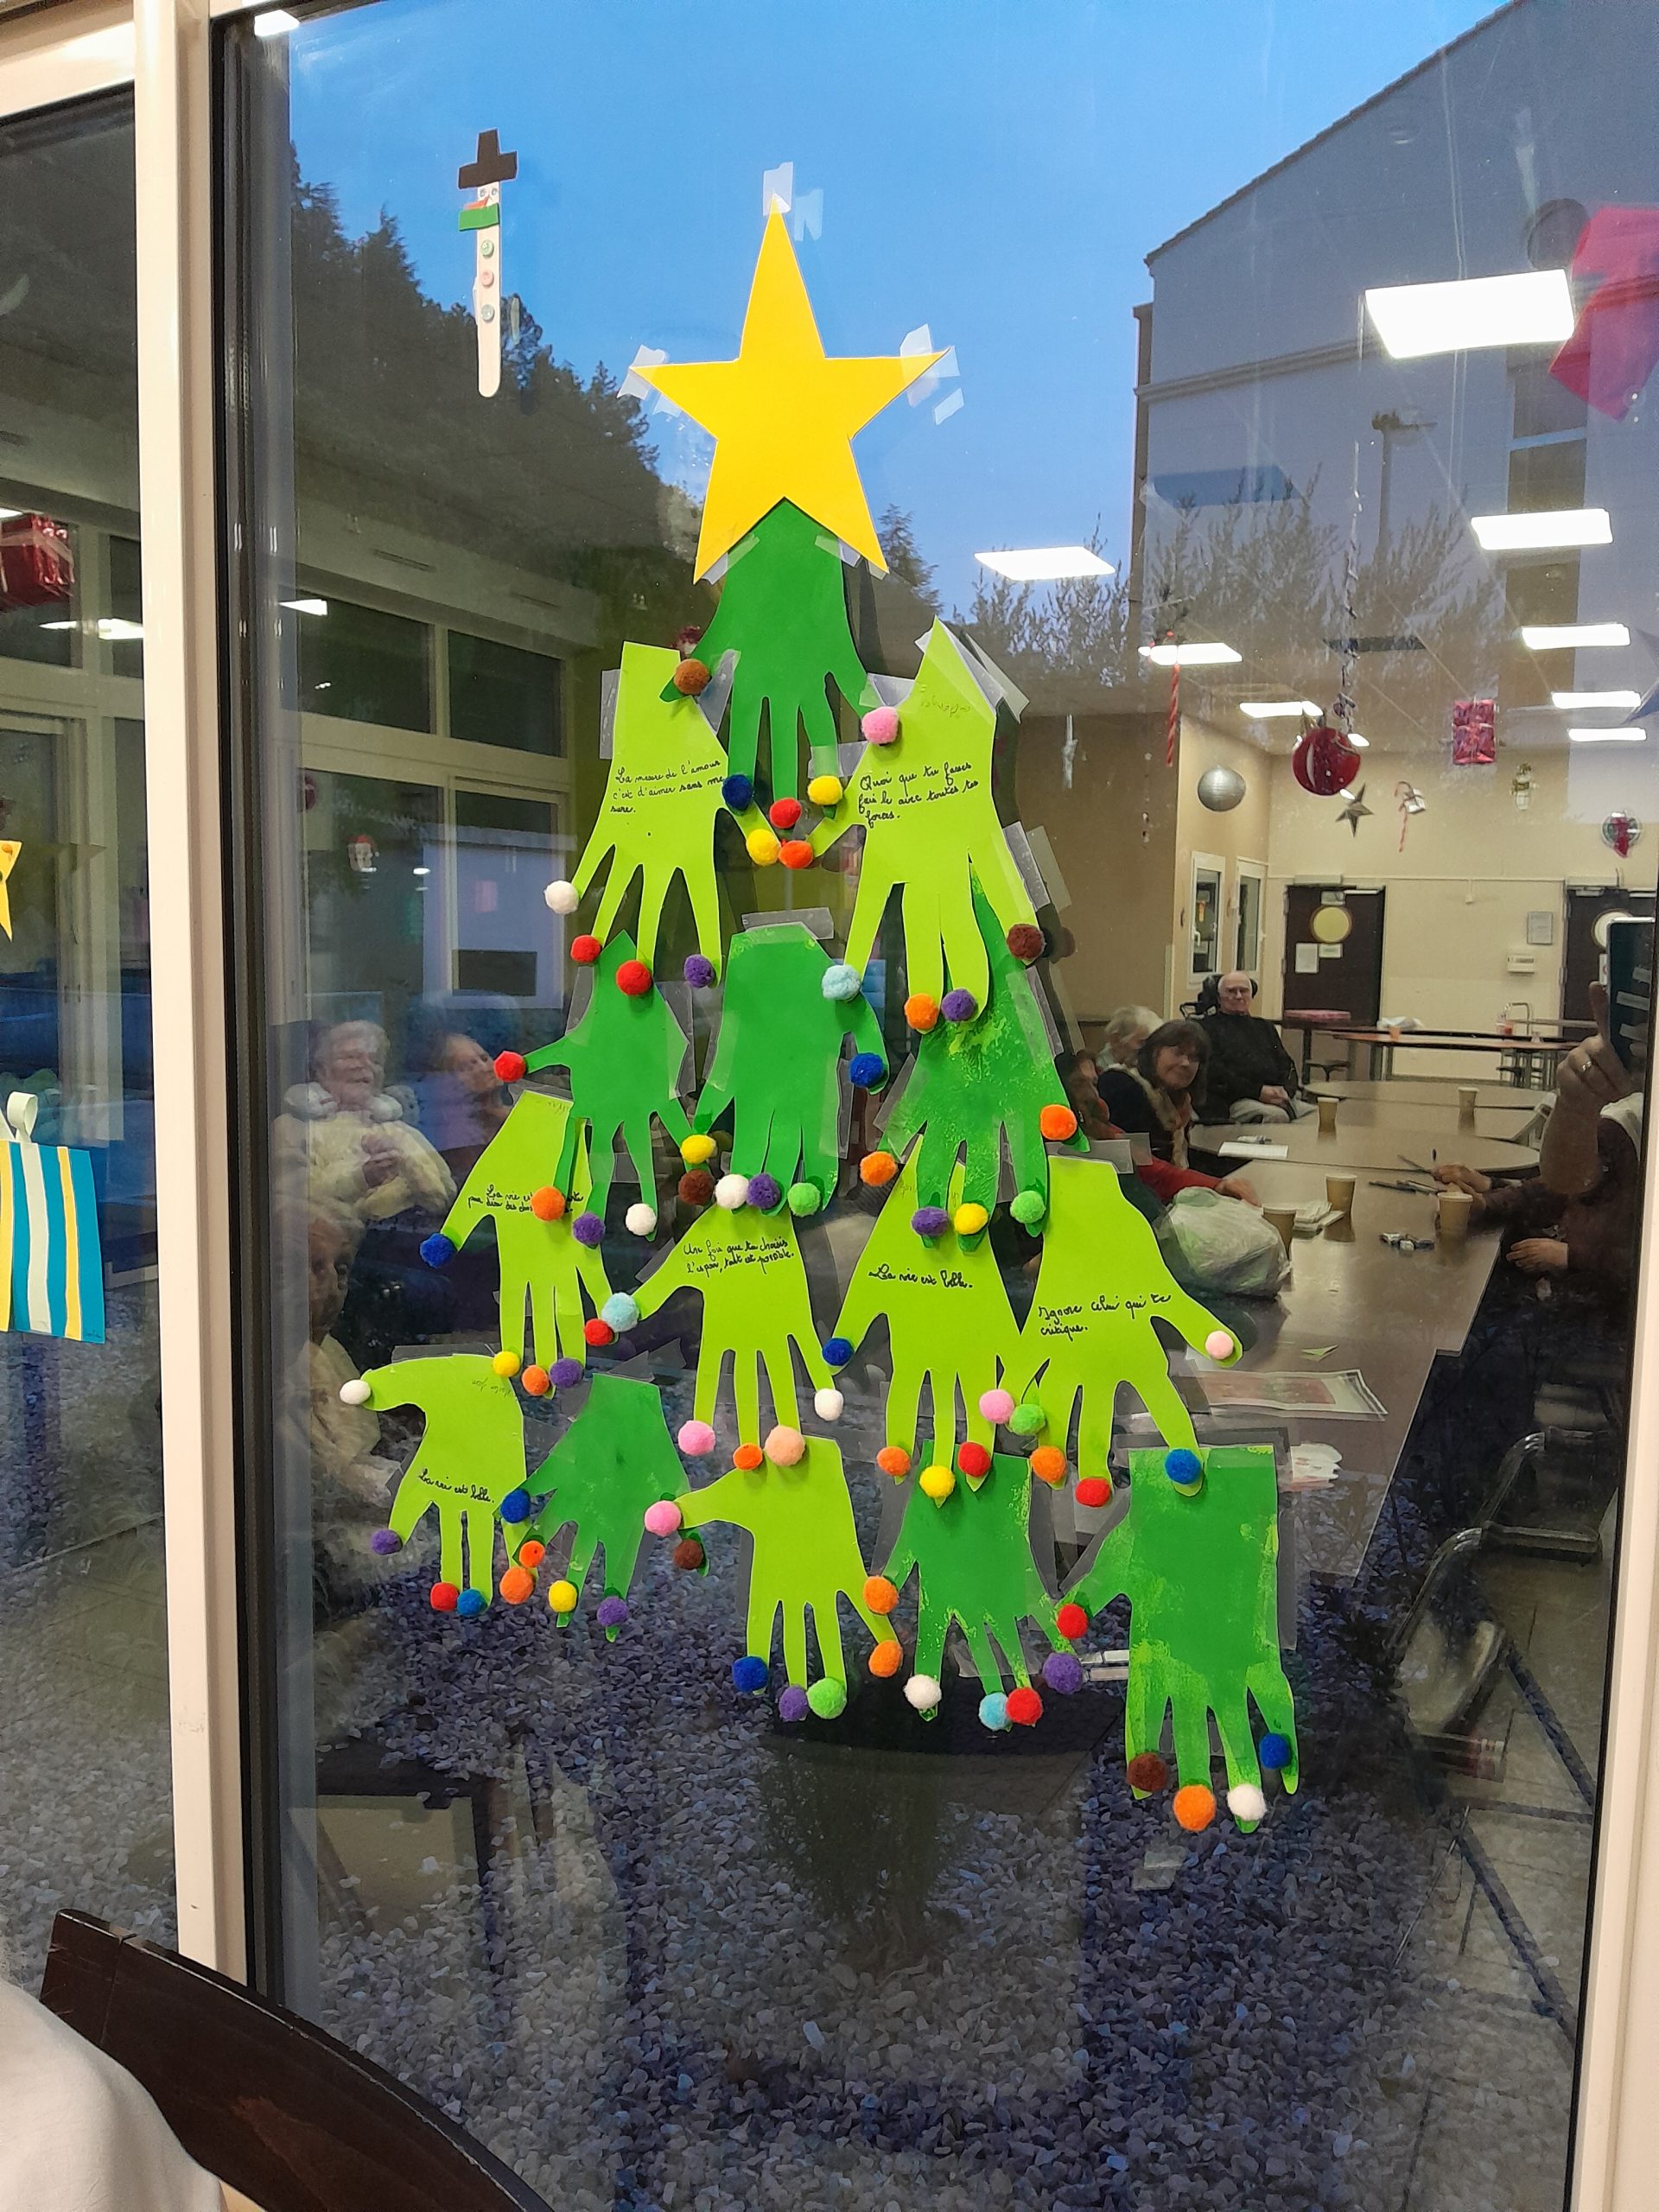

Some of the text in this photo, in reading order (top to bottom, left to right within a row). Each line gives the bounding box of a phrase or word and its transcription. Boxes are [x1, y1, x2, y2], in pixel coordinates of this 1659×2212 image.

[615, 766, 632, 784] La
[635, 774, 664, 784] mesure
[665, 768, 677, 779] de
[860, 771, 893, 791] Quoi
[899, 773, 918, 798] que
[923, 766, 939, 777] tu
[613, 787, 633, 800] c'est
[637, 785, 676, 797] d'aimer
[679, 780, 702, 792] sans
[858, 793, 877, 814] fais
[898, 795, 923, 805] avec
[925, 785, 959, 801] toutes
[962, 779, 979, 793] tes
[505, 1191, 520, 1200] vie
[705, 1239, 723, 1262] fois
[726, 1245, 744, 1262] que
[899, 1268, 918, 1282] vie
[920, 1274, 938, 1285] est
[1090, 1294, 1121, 1312] celui
[1125, 1295, 1147, 1320] qui
[1150, 1294, 1172, 1303] te
